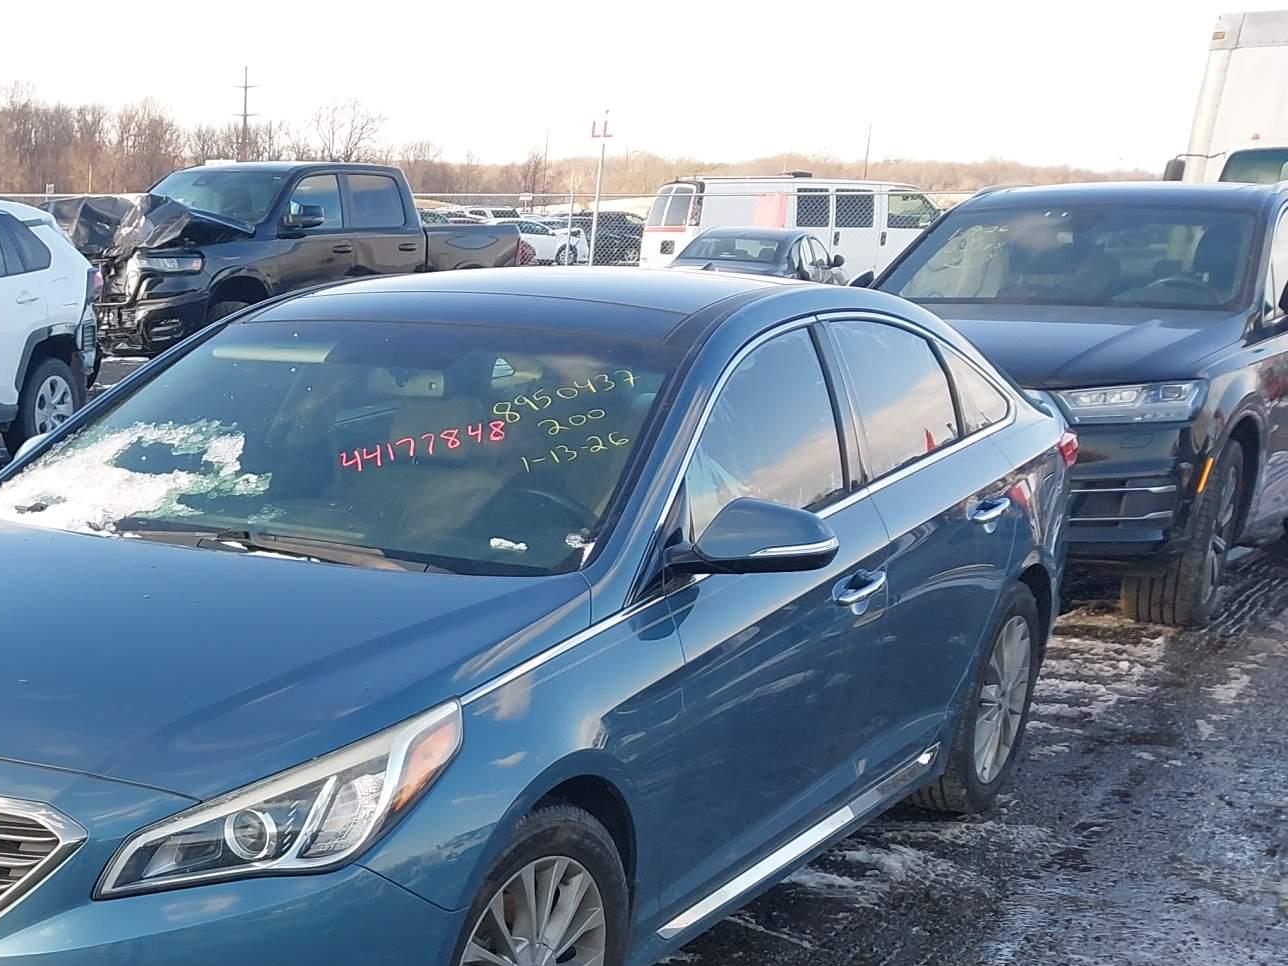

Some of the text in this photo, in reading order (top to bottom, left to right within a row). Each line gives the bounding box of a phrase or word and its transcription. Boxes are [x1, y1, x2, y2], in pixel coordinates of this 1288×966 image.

[591, 120, 614, 138] LL
[492, 369, 641, 424] 8950437
[537, 408, 606, 436] 200
[339, 420, 506, 472] 44177848
[520, 431, 630, 473] 1-13-26
